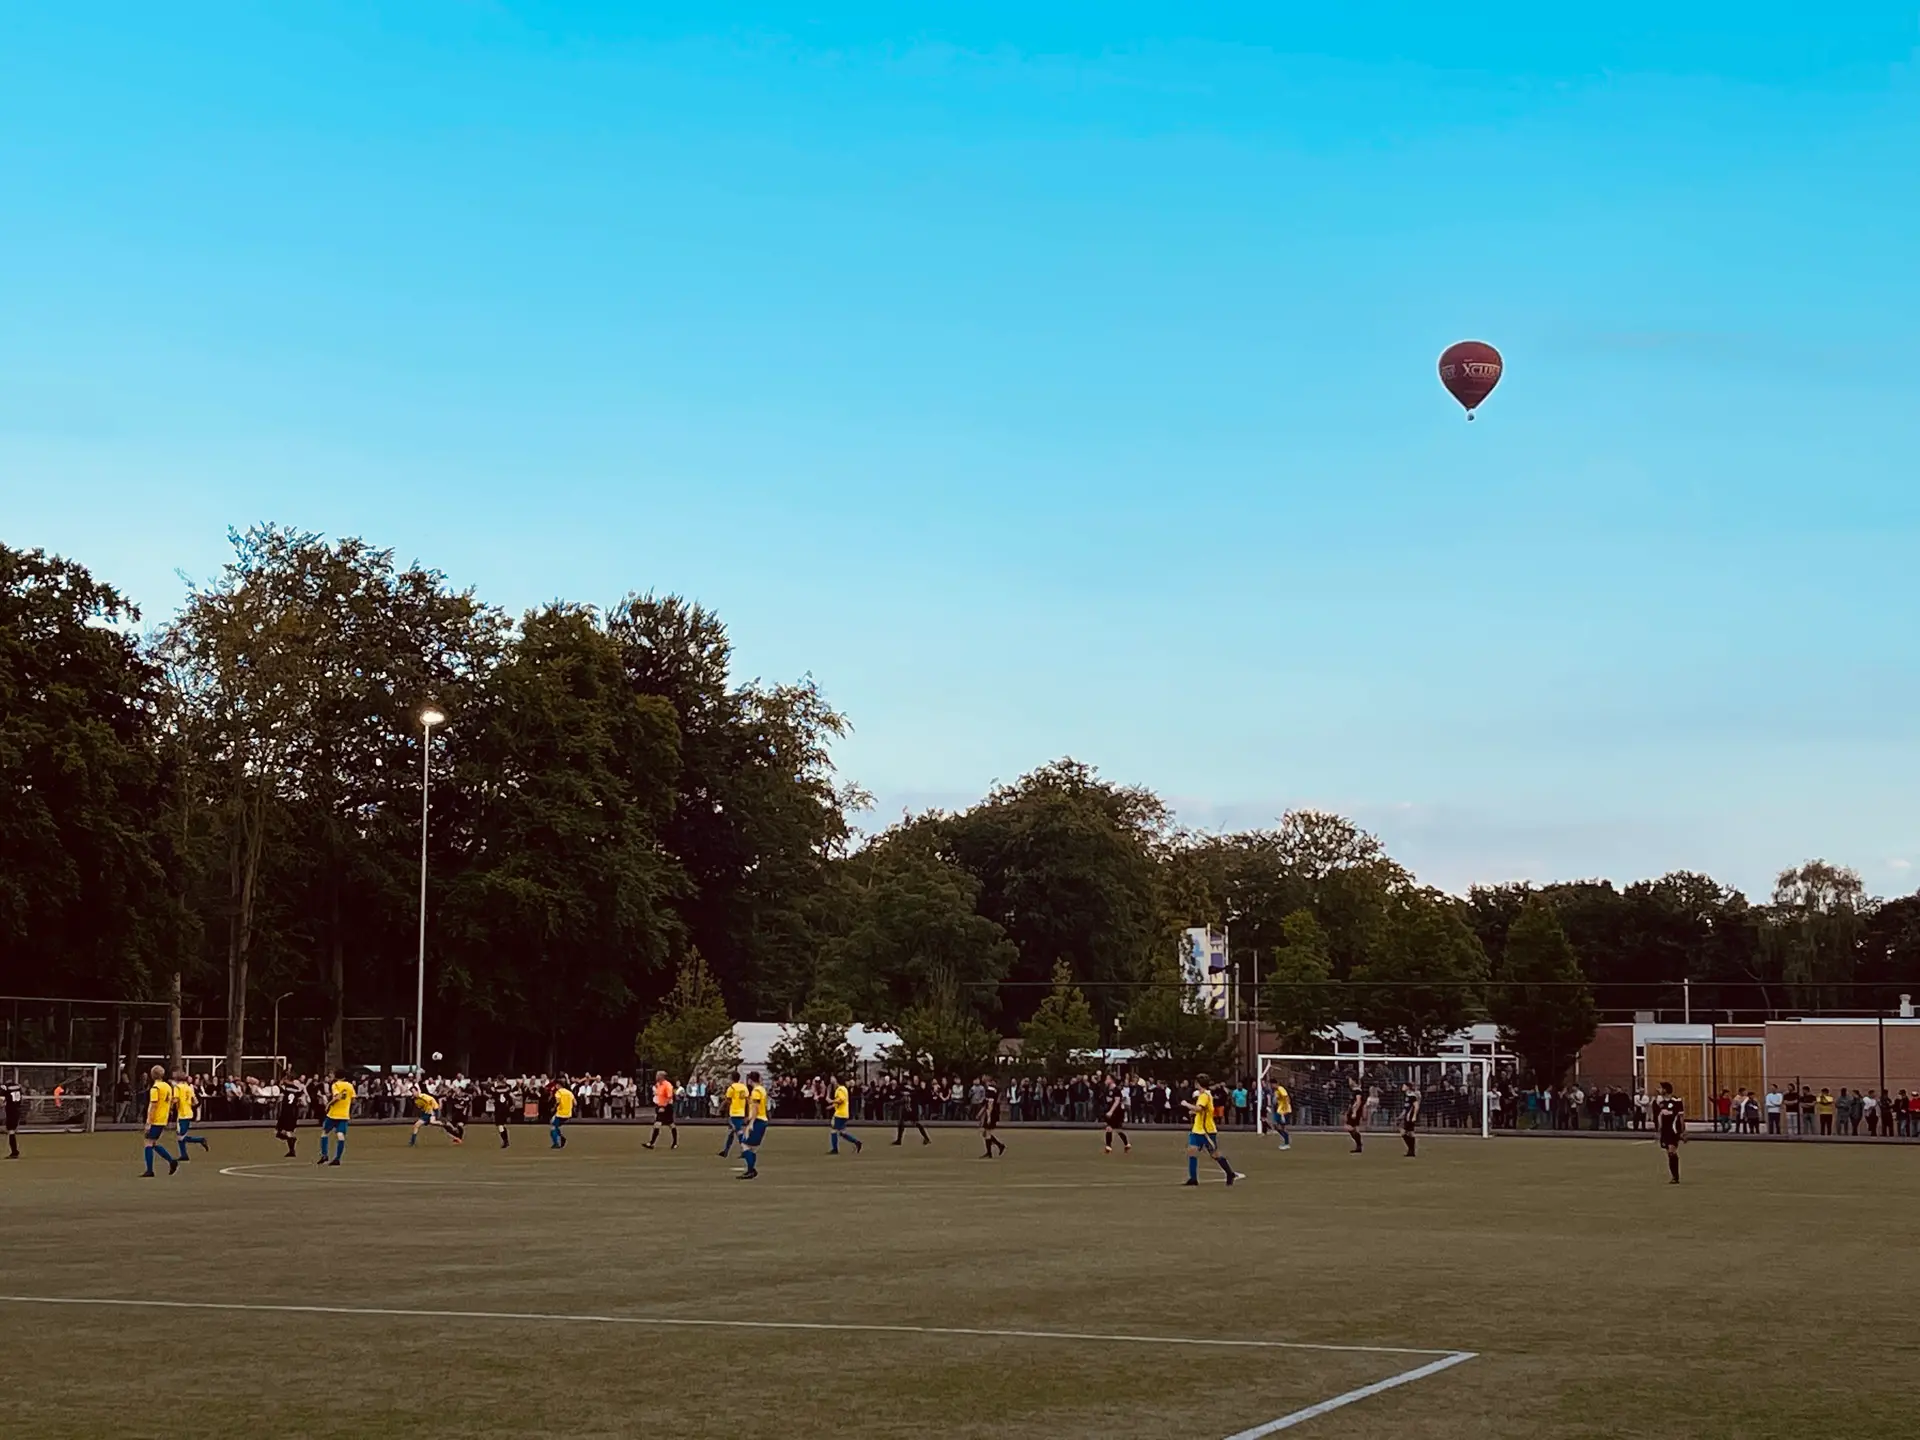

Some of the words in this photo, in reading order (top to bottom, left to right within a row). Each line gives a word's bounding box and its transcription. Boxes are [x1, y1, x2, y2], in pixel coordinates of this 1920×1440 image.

[10, 1091, 21, 1102] 10
[288, 1093, 295, 1104] 9
[499, 1093, 506, 1103] 6
